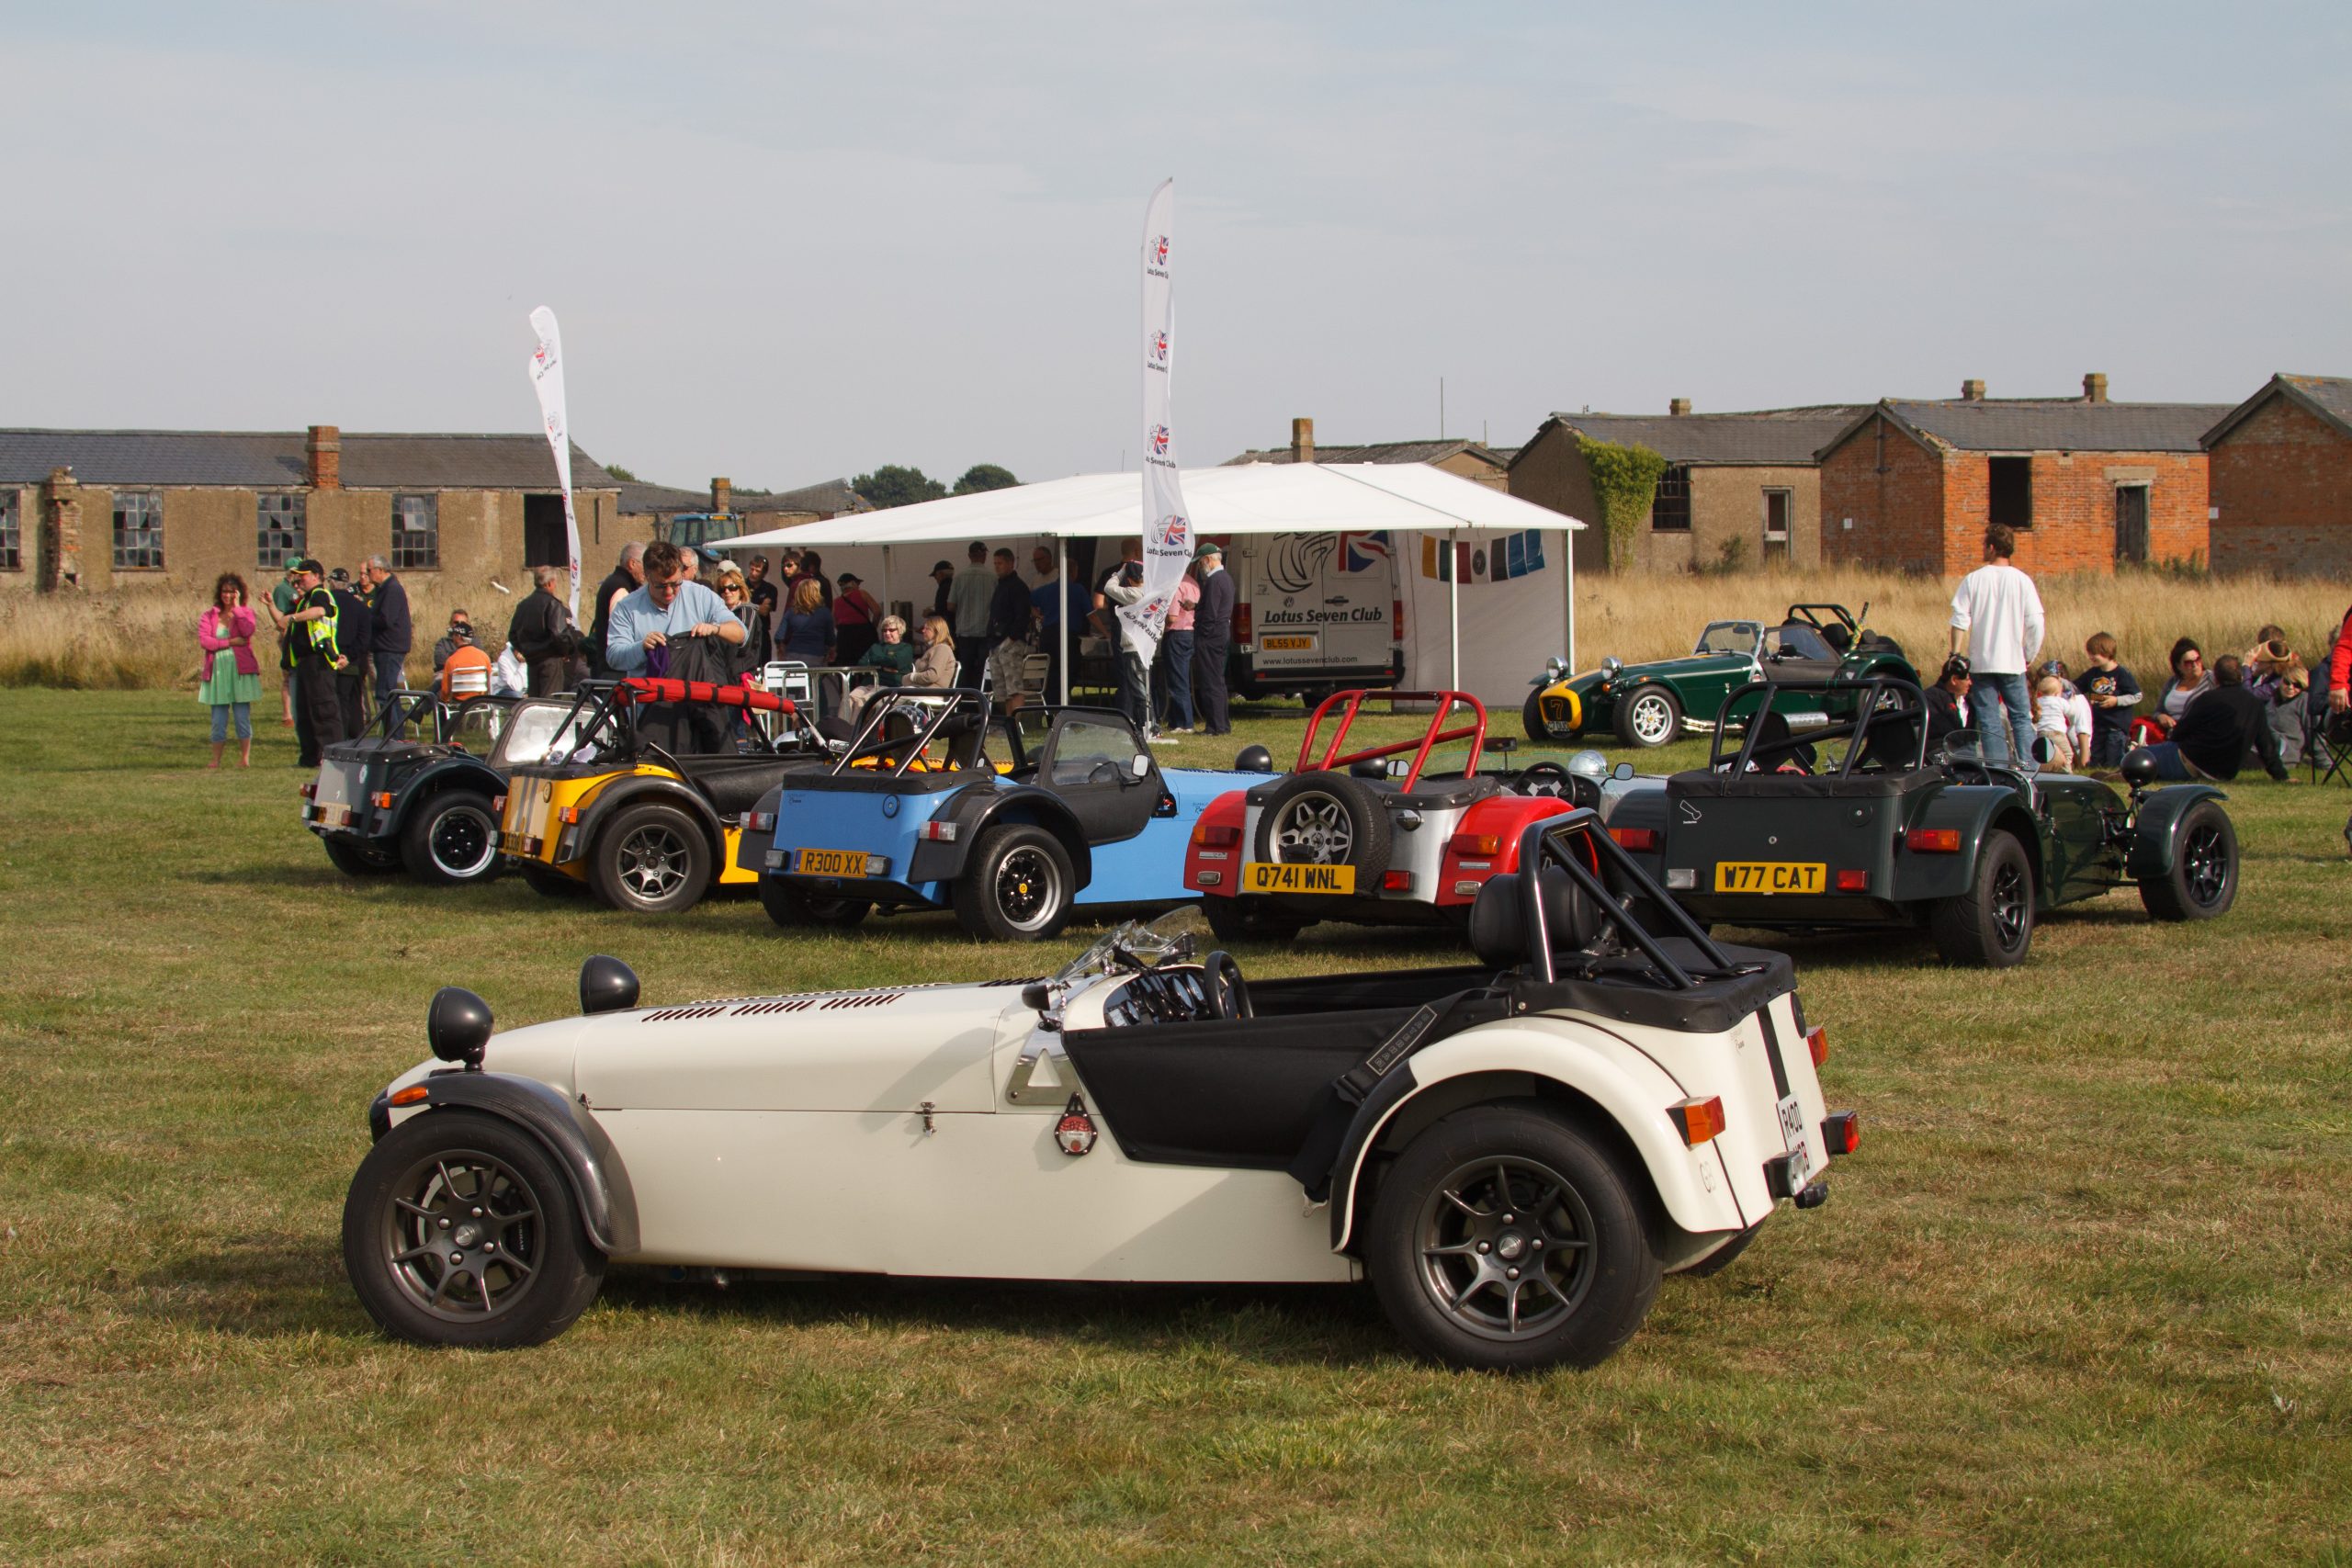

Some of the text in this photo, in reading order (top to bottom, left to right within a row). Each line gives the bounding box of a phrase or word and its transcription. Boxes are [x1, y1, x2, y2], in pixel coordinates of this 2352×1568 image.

[1150, 457, 1165, 467] Seven
[1166, 460, 1176, 468] Club
[1159, 548, 1182, 557] Seven
[1264, 607, 1382, 624] Lotus Seven Club
[1262, 655, 1358, 665] www.lotussevenclub.com
[1550, 699, 1563, 720] 7
[805, 852, 864, 874] R300 XX
[1257, 866, 1342, 890] Q741 WNL
[1724, 866, 1817, 889] W77 CAT
[1781, 1100, 1803, 1139] R400
